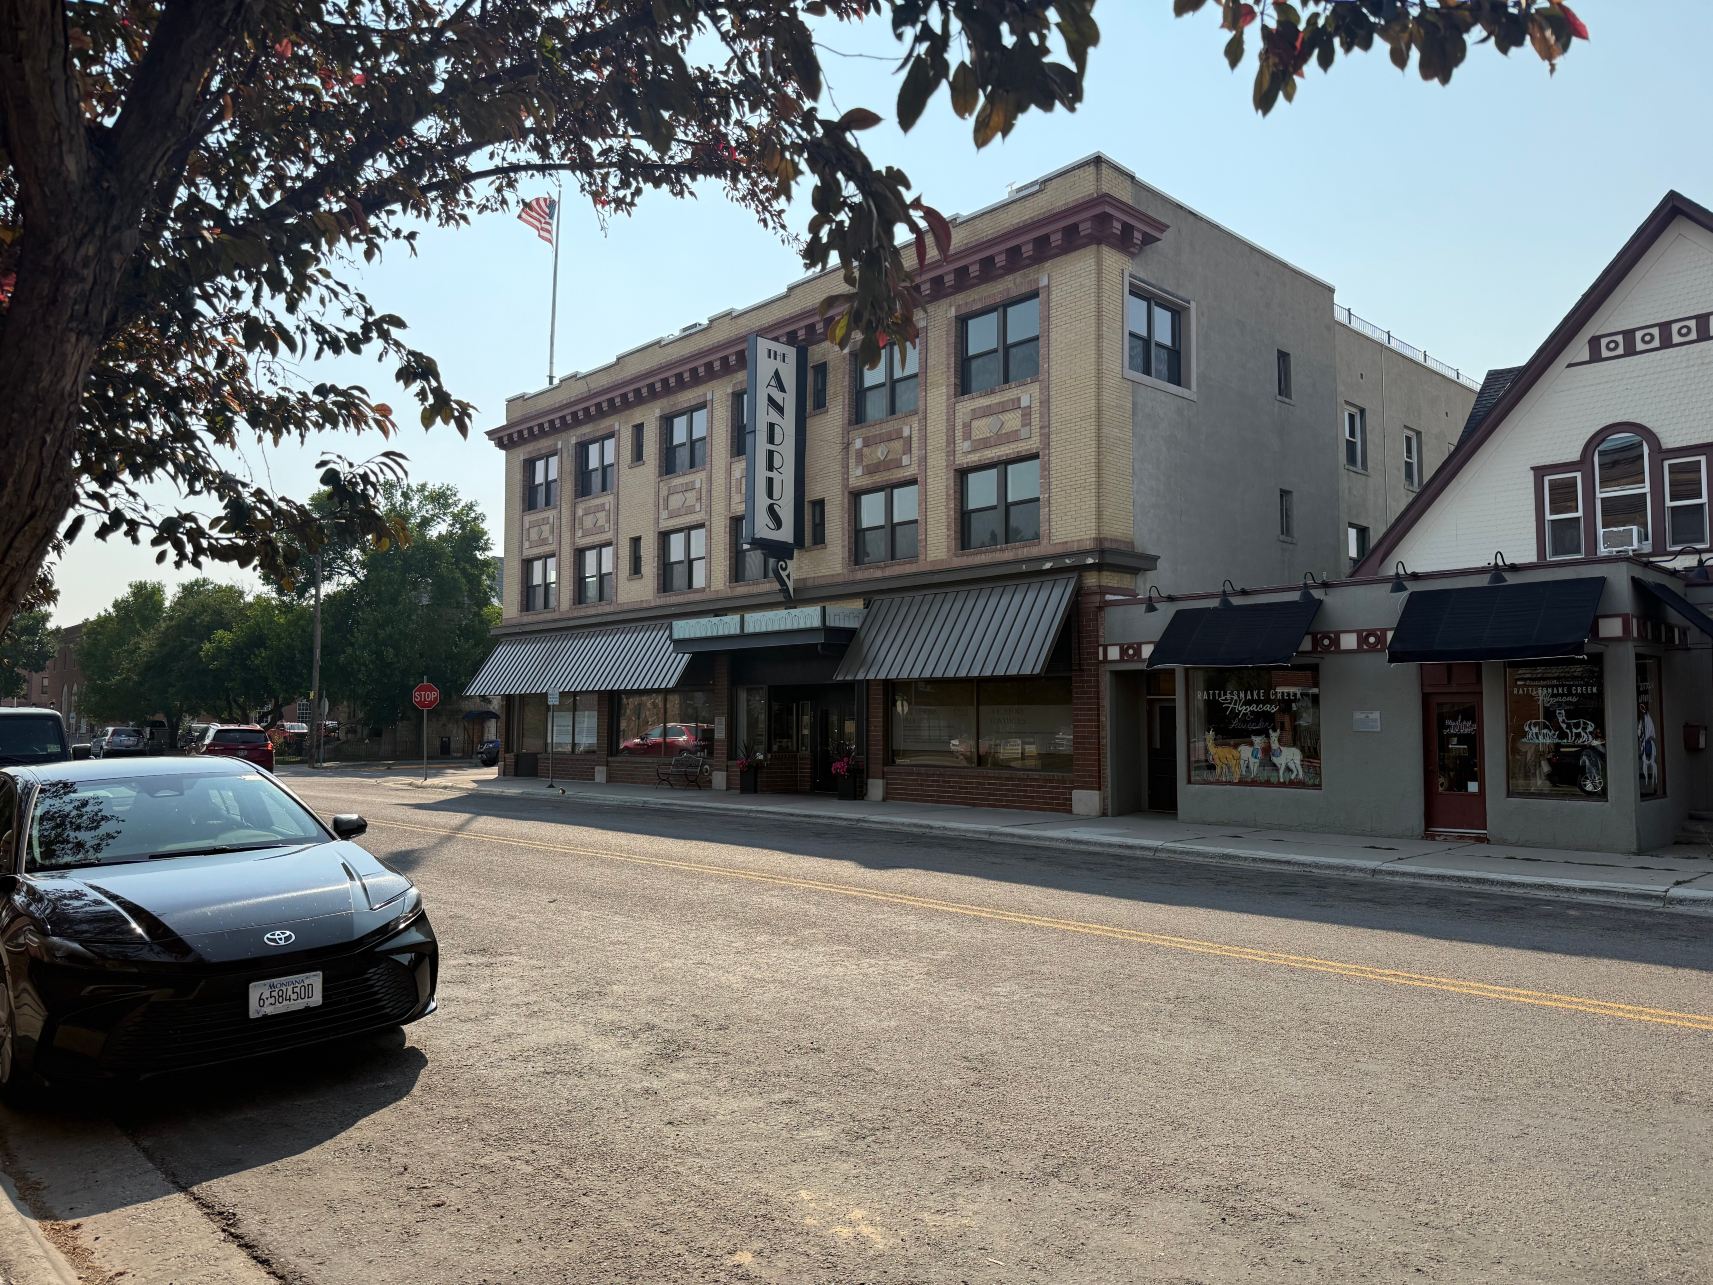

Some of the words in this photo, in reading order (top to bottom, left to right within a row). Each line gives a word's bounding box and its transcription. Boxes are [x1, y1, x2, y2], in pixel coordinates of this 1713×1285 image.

[766, 347, 790, 365] THE
[765, 367, 787, 532] ANDRUS
[415, 691, 437, 702] STOP
[1197, 689, 1265, 700] RATTLESNAKE
[1270, 689, 1303, 700] CREEK
[1513, 686, 1568, 695] RATTLESNAKE
[1572, 686, 1598, 694] CREEK
[1219, 695, 1280, 718] Alpacas
